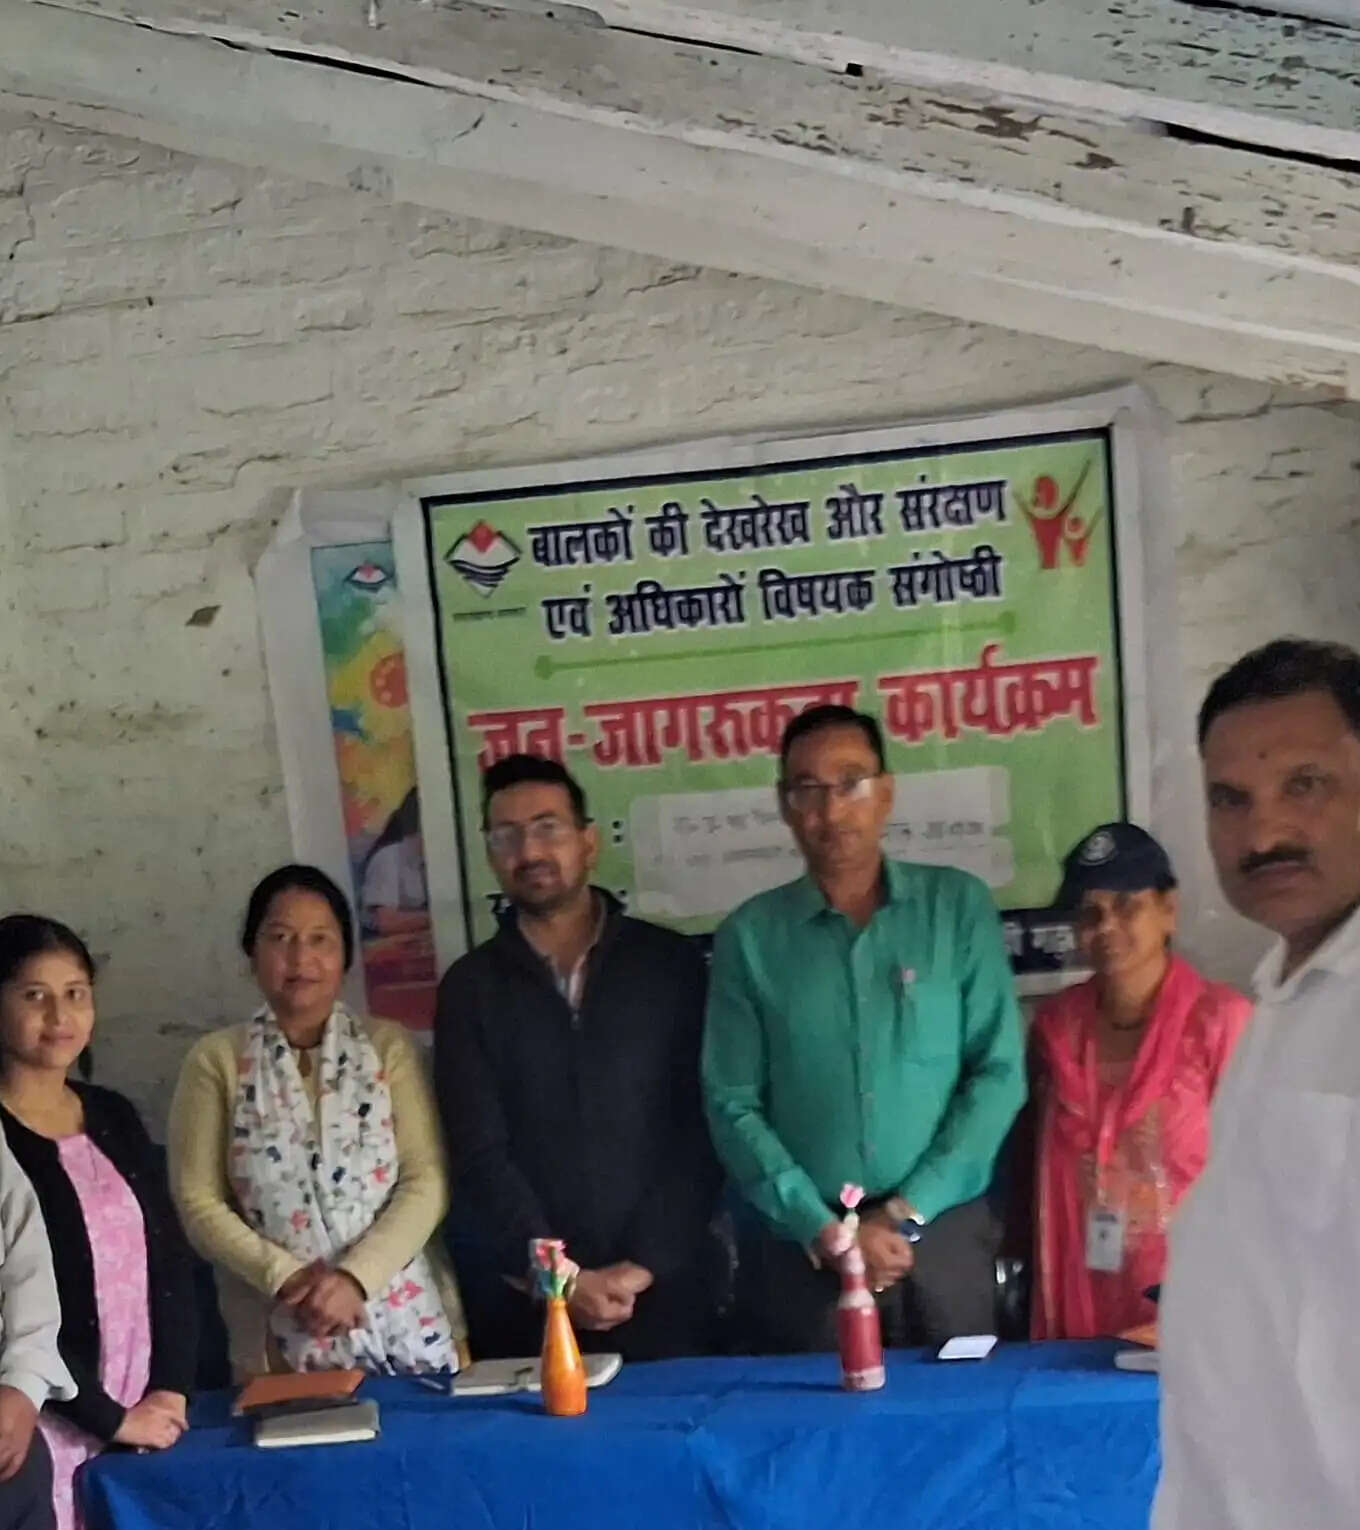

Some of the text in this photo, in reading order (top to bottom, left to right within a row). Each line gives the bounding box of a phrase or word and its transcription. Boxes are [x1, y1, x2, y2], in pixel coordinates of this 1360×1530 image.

[529, 505, 633, 566] बालकों
[646, 502, 688, 556] की
[701, 496, 811, 552] देखरेख
[827, 485, 883, 539] और
[542, 546, 1002, 640] एवं अधिकारों विषयक संगोष्ठी
[878, 645, 1099, 742] कार्यक्रम
